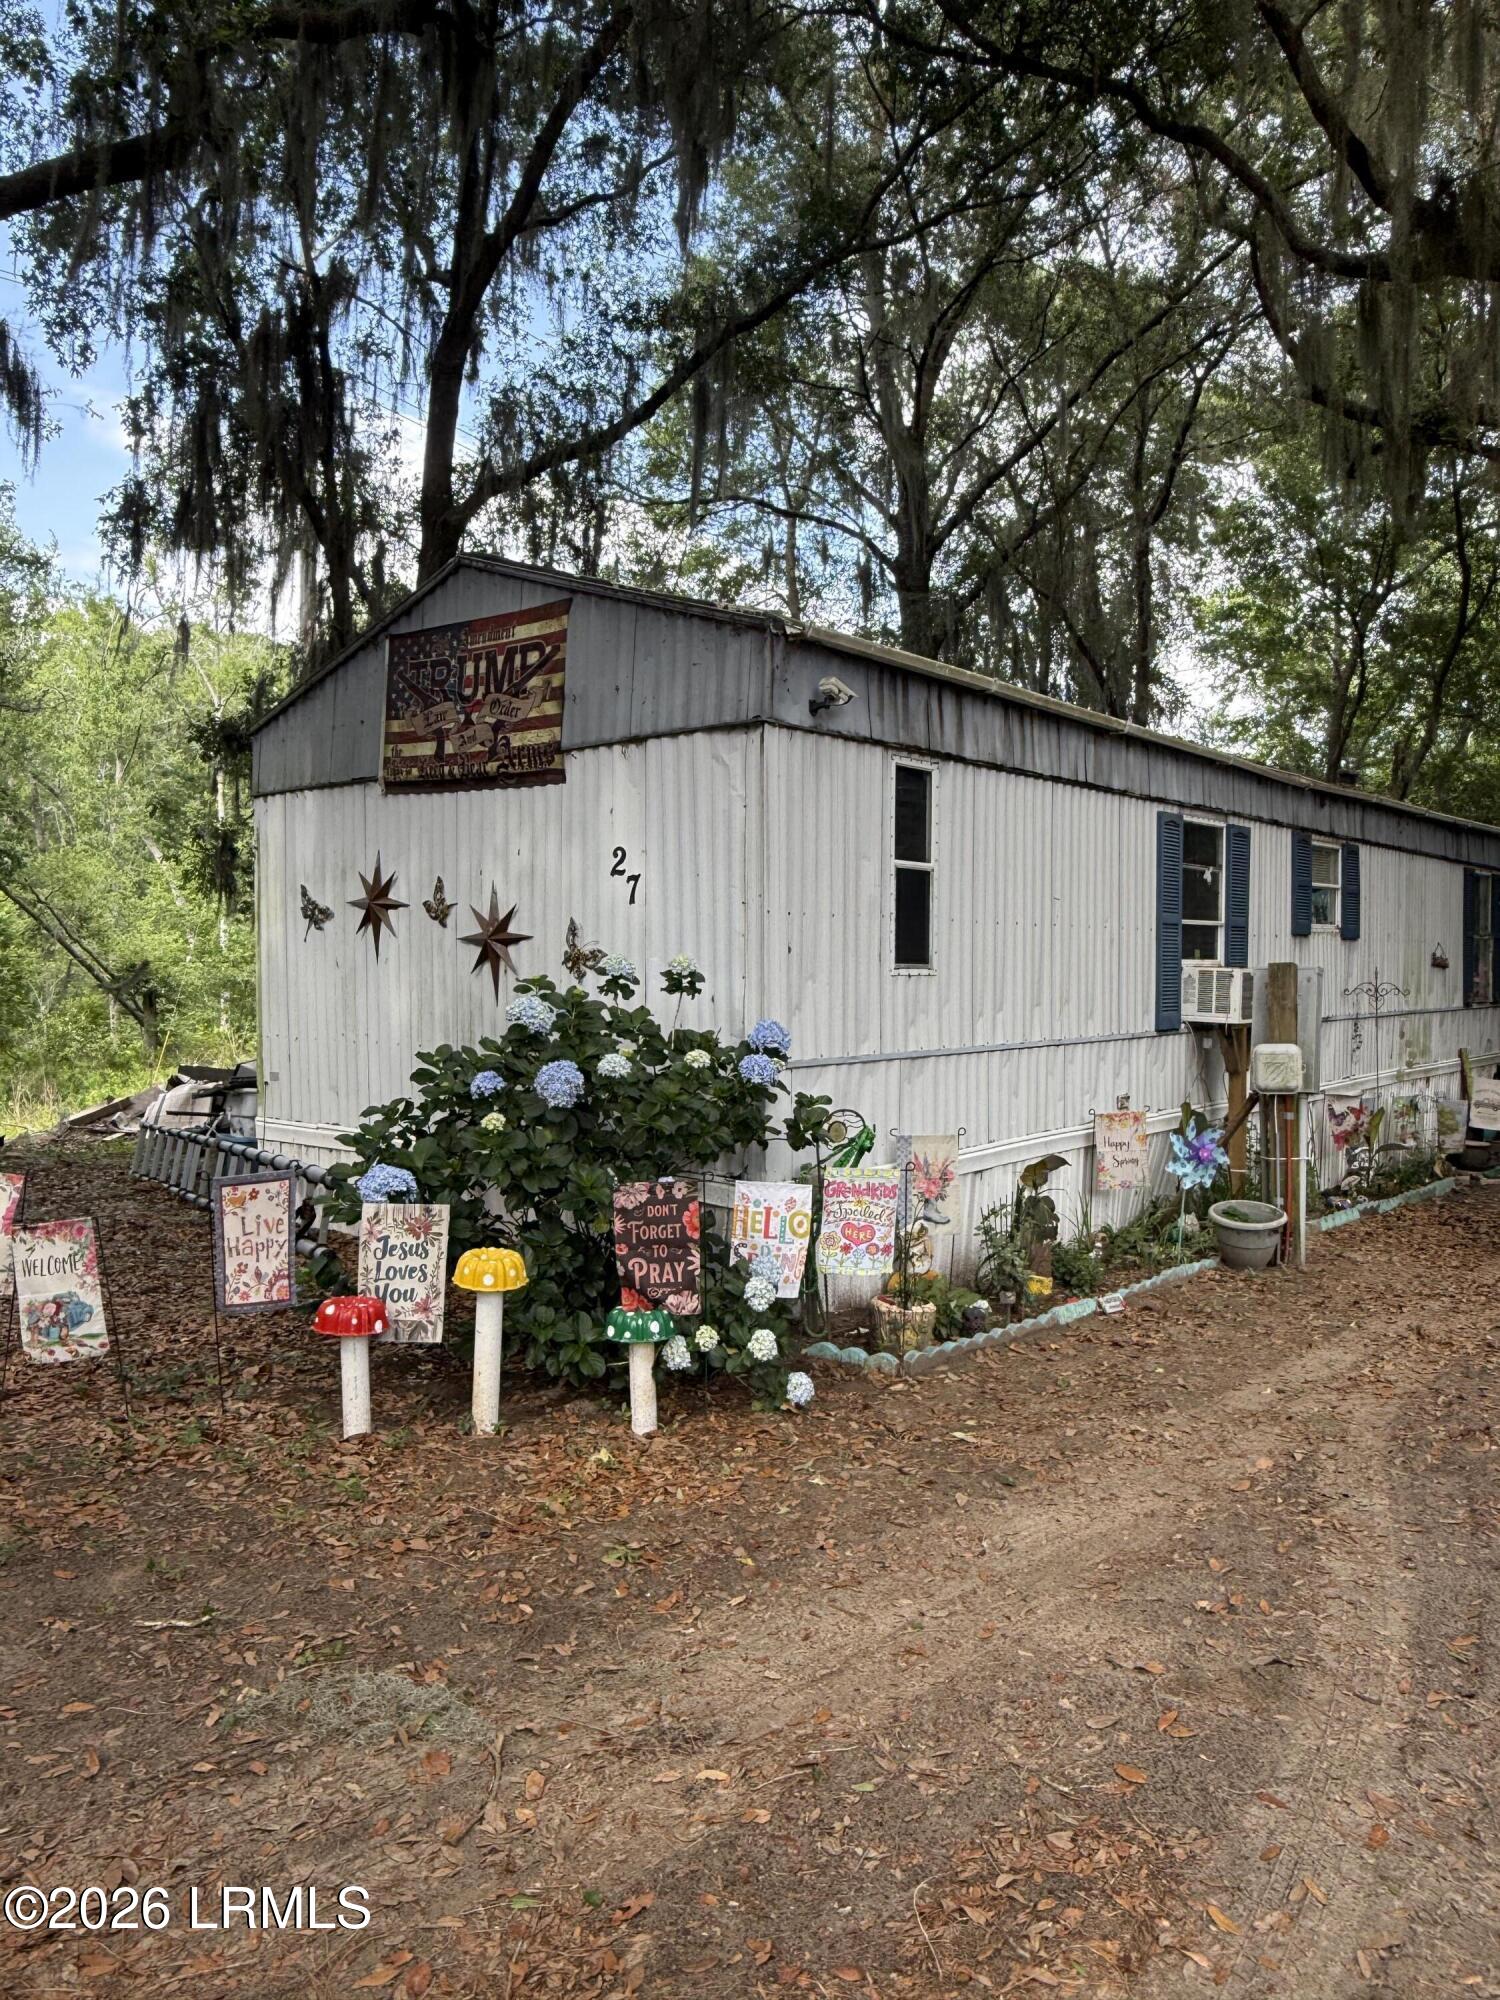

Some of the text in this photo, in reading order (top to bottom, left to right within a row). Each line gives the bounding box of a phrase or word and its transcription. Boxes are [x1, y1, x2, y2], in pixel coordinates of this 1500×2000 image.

[407, 640, 548, 707] TRUMP
[489, 697, 521, 718] Order
[424, 710, 448, 729] Law
[1103, 1135, 1130, 1152] Happy
[1112, 1154, 1139, 1168] Spring
[647, 1203, 678, 1218] DON'T
[241, 1214, 285, 1237] Live
[627, 1220, 682, 1243] FORGET
[732, 1203, 811, 1245] HELLO
[844, 1227, 872, 1241] HERE
[226, 1237, 288, 1263] Happy
[373, 1234, 429, 1260] Jesus
[652, 1244, 668, 1258] TO
[22, 1252, 81, 1278] WELCOME
[373, 1261, 428, 1283] Loves
[627, 1257, 685, 1289] PRAY
[374, 1284, 419, 1304] You
